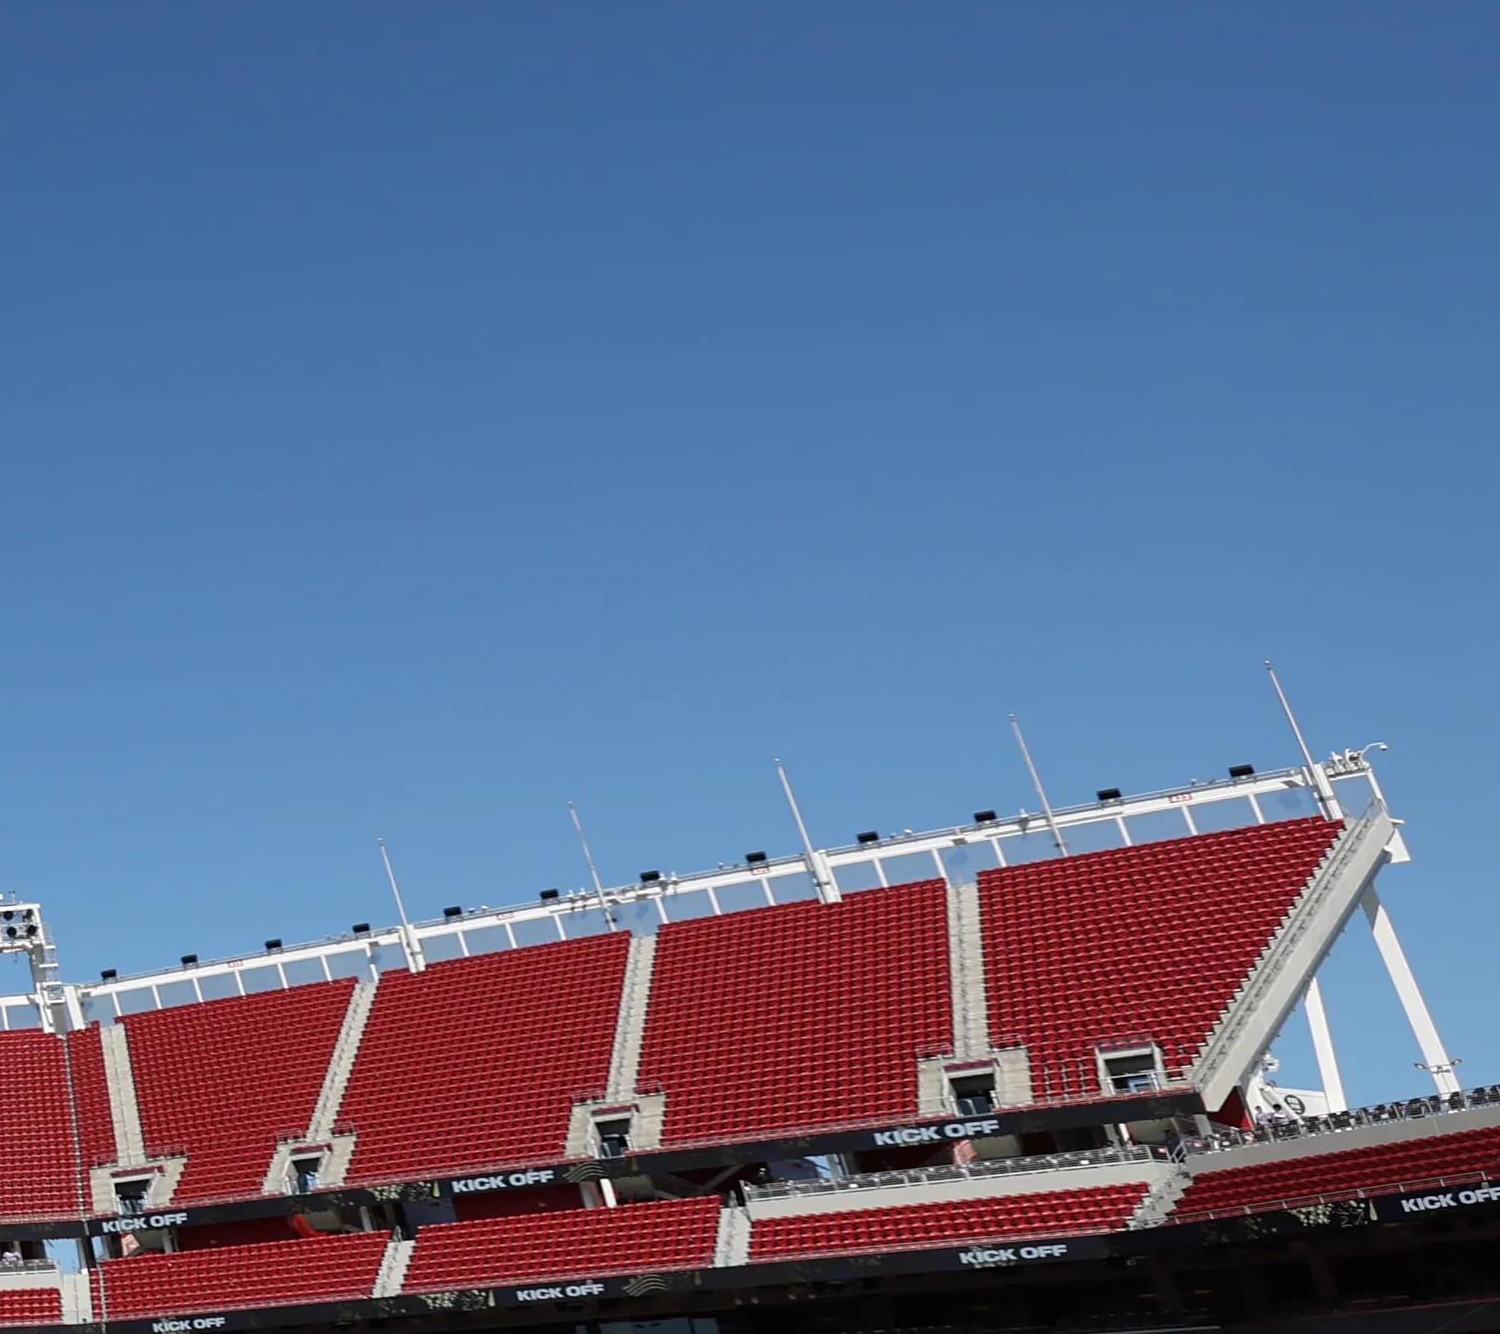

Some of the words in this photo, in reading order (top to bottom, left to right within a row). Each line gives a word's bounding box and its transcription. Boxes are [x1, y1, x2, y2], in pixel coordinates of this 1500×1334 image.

[874, 1127, 941, 1145] KICK
[944, 1120, 999, 1137] OFF
[452, 1176, 506, 1192] KICK
[509, 1170, 554, 1186] OFF
[1401, 1194, 1457, 1212] KICK
[1459, 1187, 1500, 1204] OFF
[102, 1218, 147, 1233] KICK
[150, 1213, 187, 1227] OFF
[959, 1247, 1017, 1267] KICK
[1020, 1245, 1067, 1258] OFF
[517, 1288, 563, 1301] KICK
[566, 1282, 604, 1296] OFF
